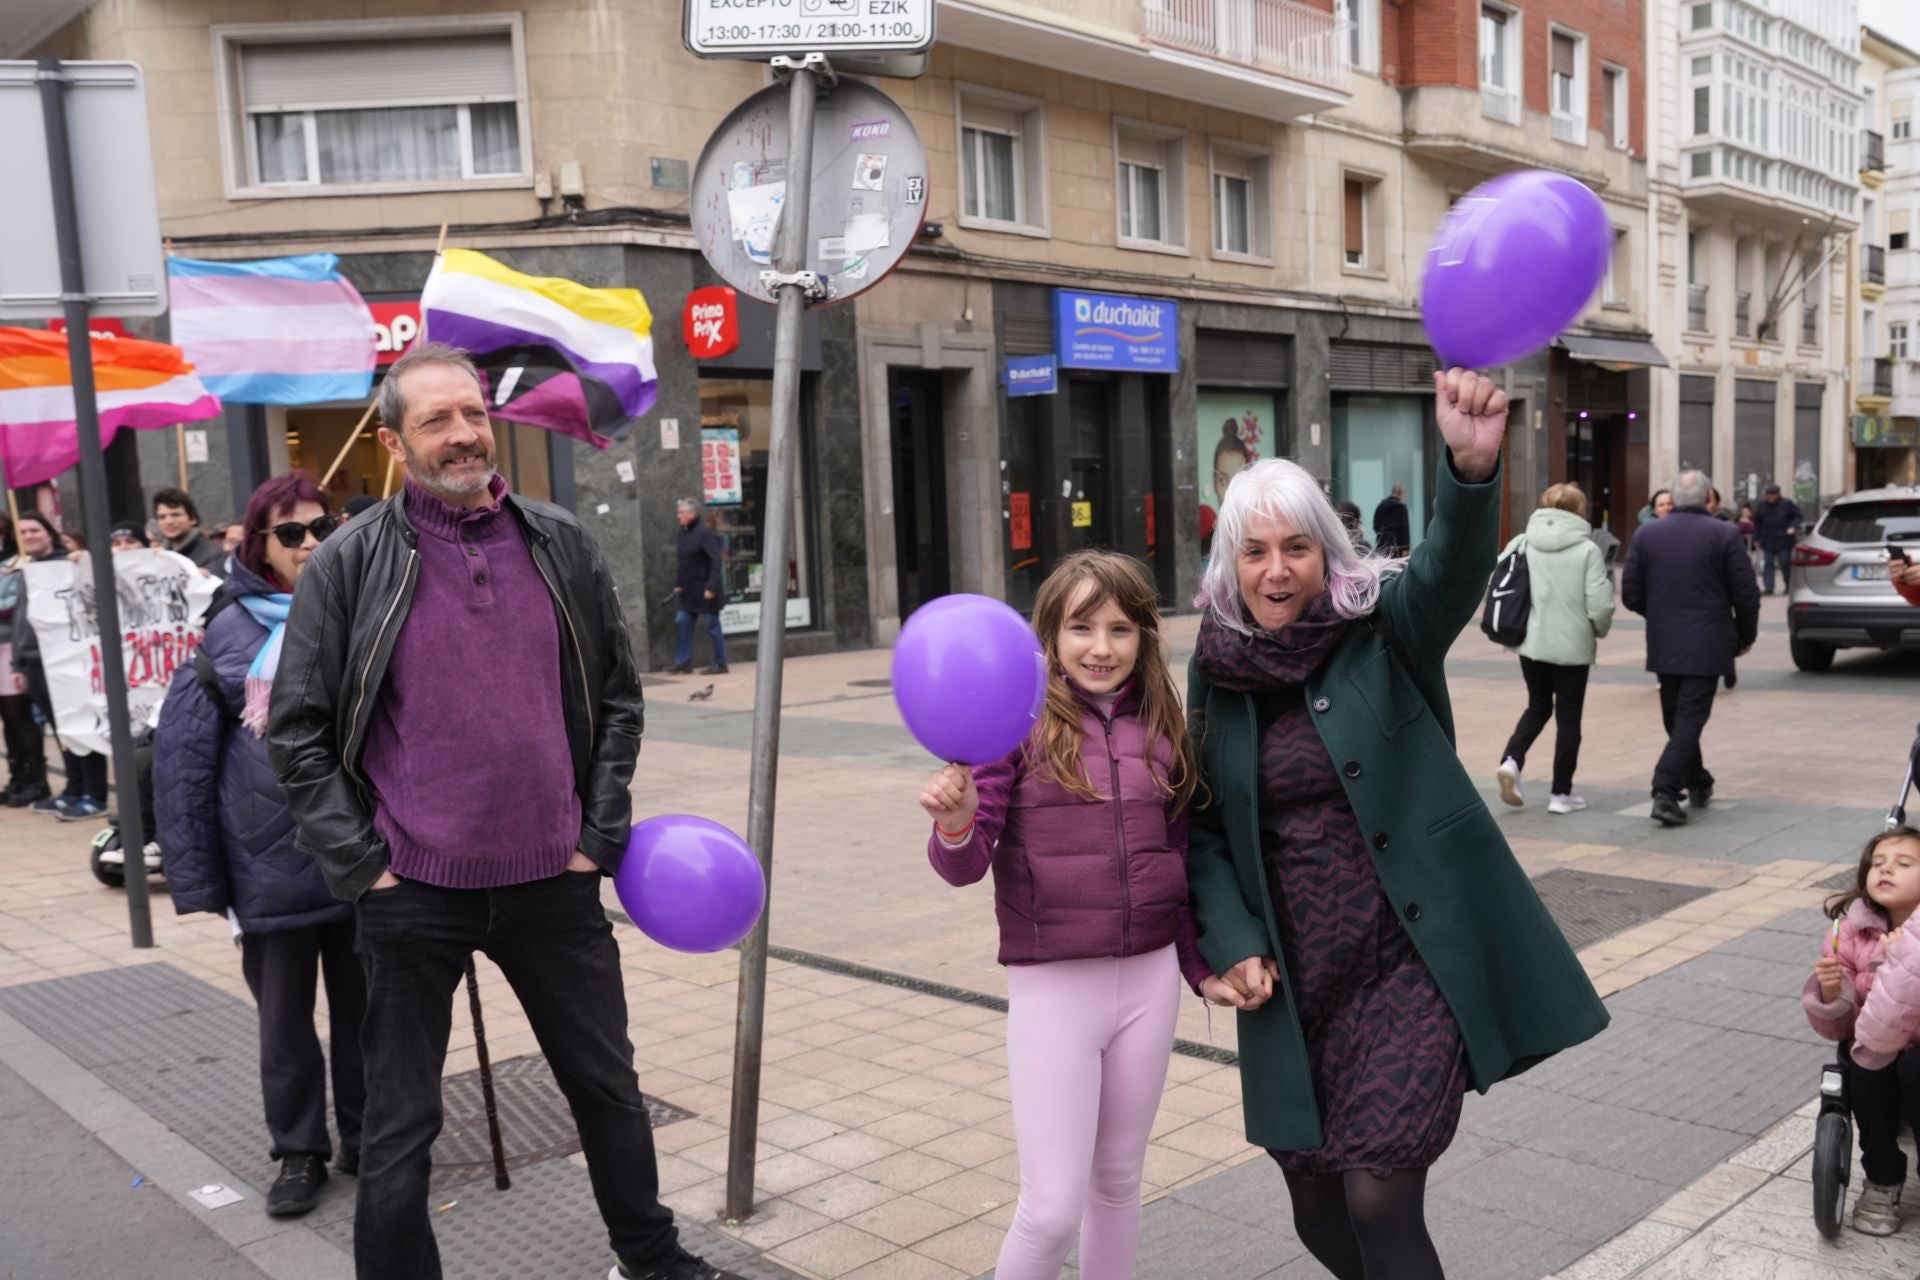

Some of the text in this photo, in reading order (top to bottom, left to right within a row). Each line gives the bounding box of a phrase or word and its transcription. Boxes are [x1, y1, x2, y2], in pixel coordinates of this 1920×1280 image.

[869, 0, 908, 15] EZIK
[708, 25, 800, 40] 13:00-17:30
[818, 22, 912, 38] 21:00-11:00
[852, 123, 890, 138] KOKO
[692, 303, 724, 321] Prima
[1093, 301, 1162, 328] duchakit
